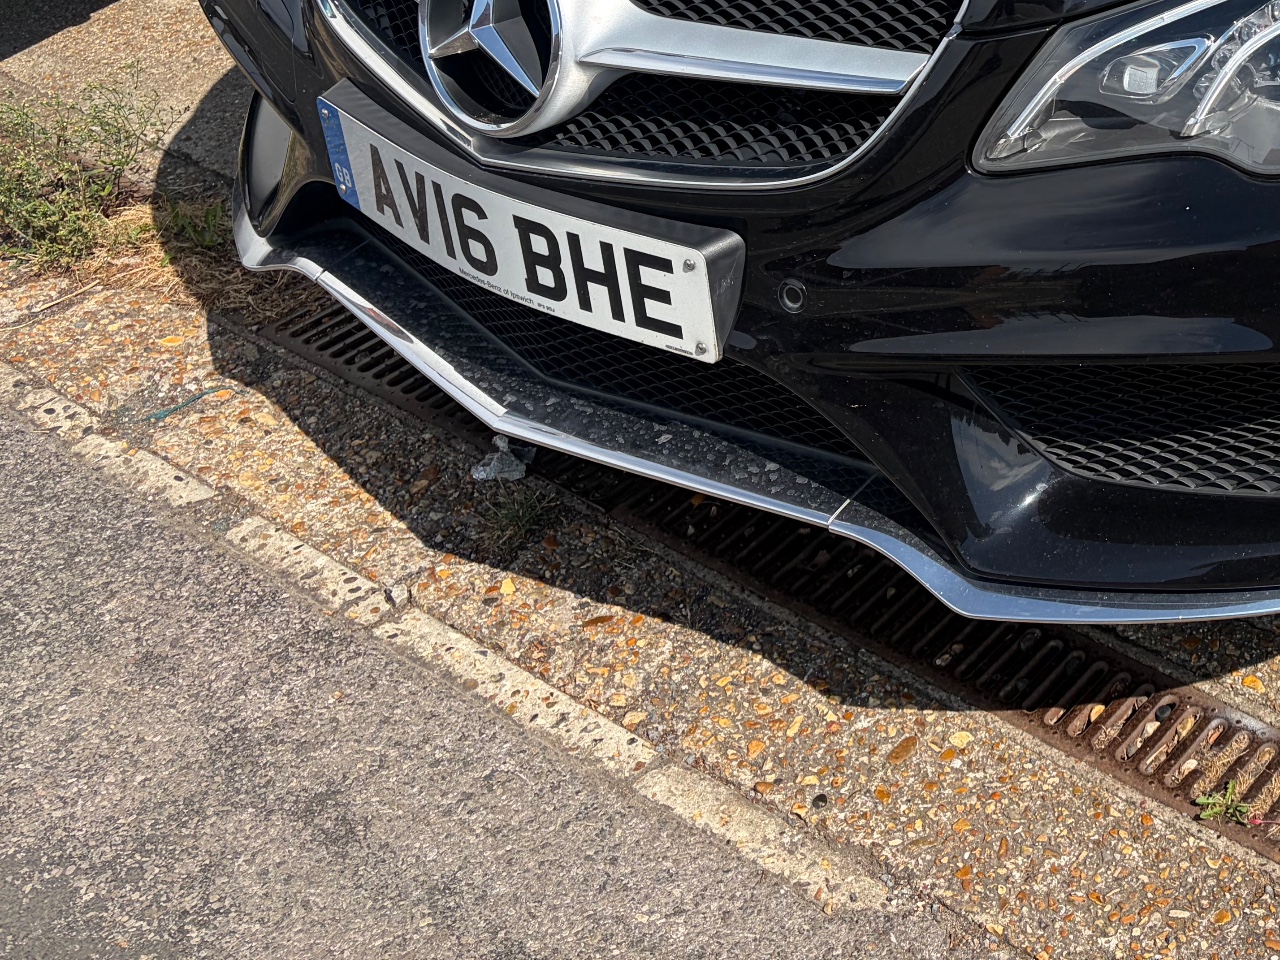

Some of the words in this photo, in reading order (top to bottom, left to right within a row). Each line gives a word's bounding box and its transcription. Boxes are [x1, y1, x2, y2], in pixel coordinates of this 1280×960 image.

[335, 162, 352, 188] GB
[369, 143, 498, 277] AV16
[512, 214, 684, 340] BHE
[458, 267, 502, 293] Mercedes-Benz
[503, 288, 510, 296] of
[510, 290, 534, 306] Ipswich
